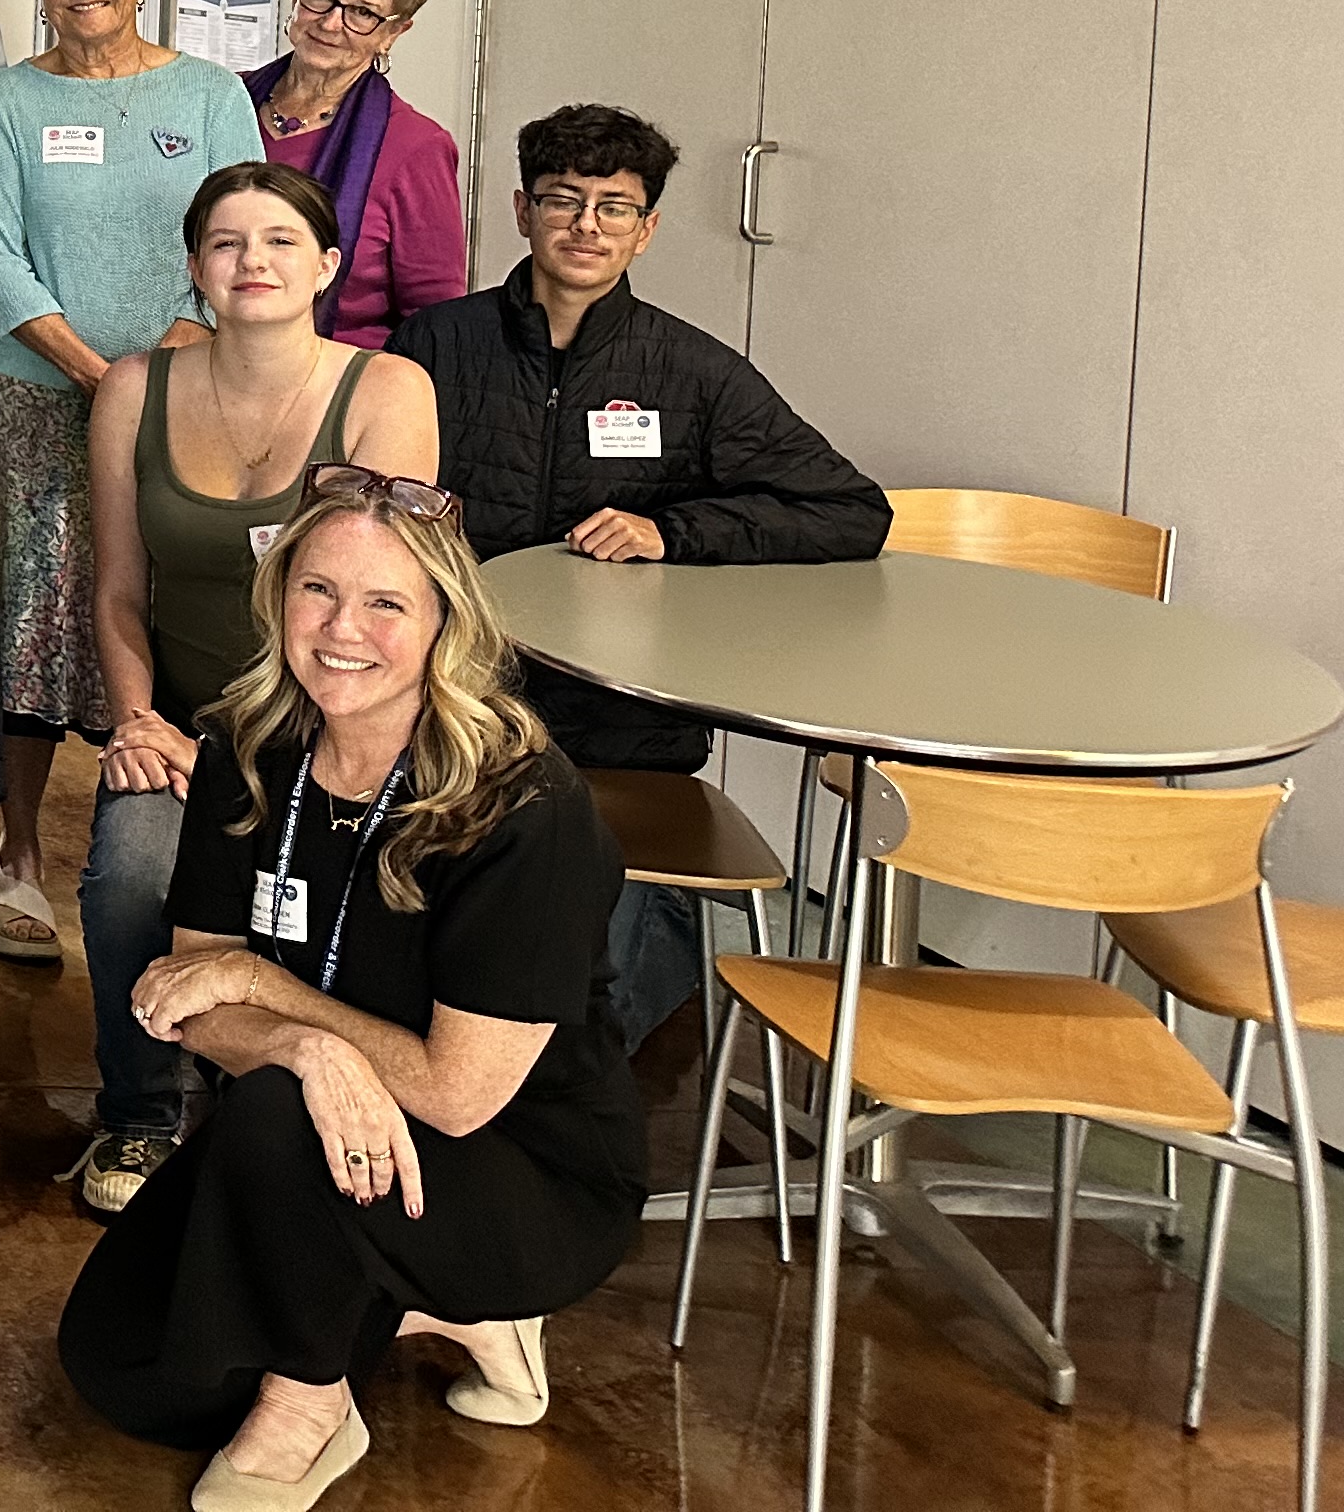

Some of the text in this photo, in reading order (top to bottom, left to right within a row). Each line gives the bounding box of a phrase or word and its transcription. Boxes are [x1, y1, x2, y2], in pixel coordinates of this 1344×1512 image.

[157, 130, 188, 148] VOTE
[292, 752, 312, 797] Elections
[290, 799, 300, 807] &
[362, 769, 404, 844] San Luis Obispo
[327, 952, 337, 961] &
